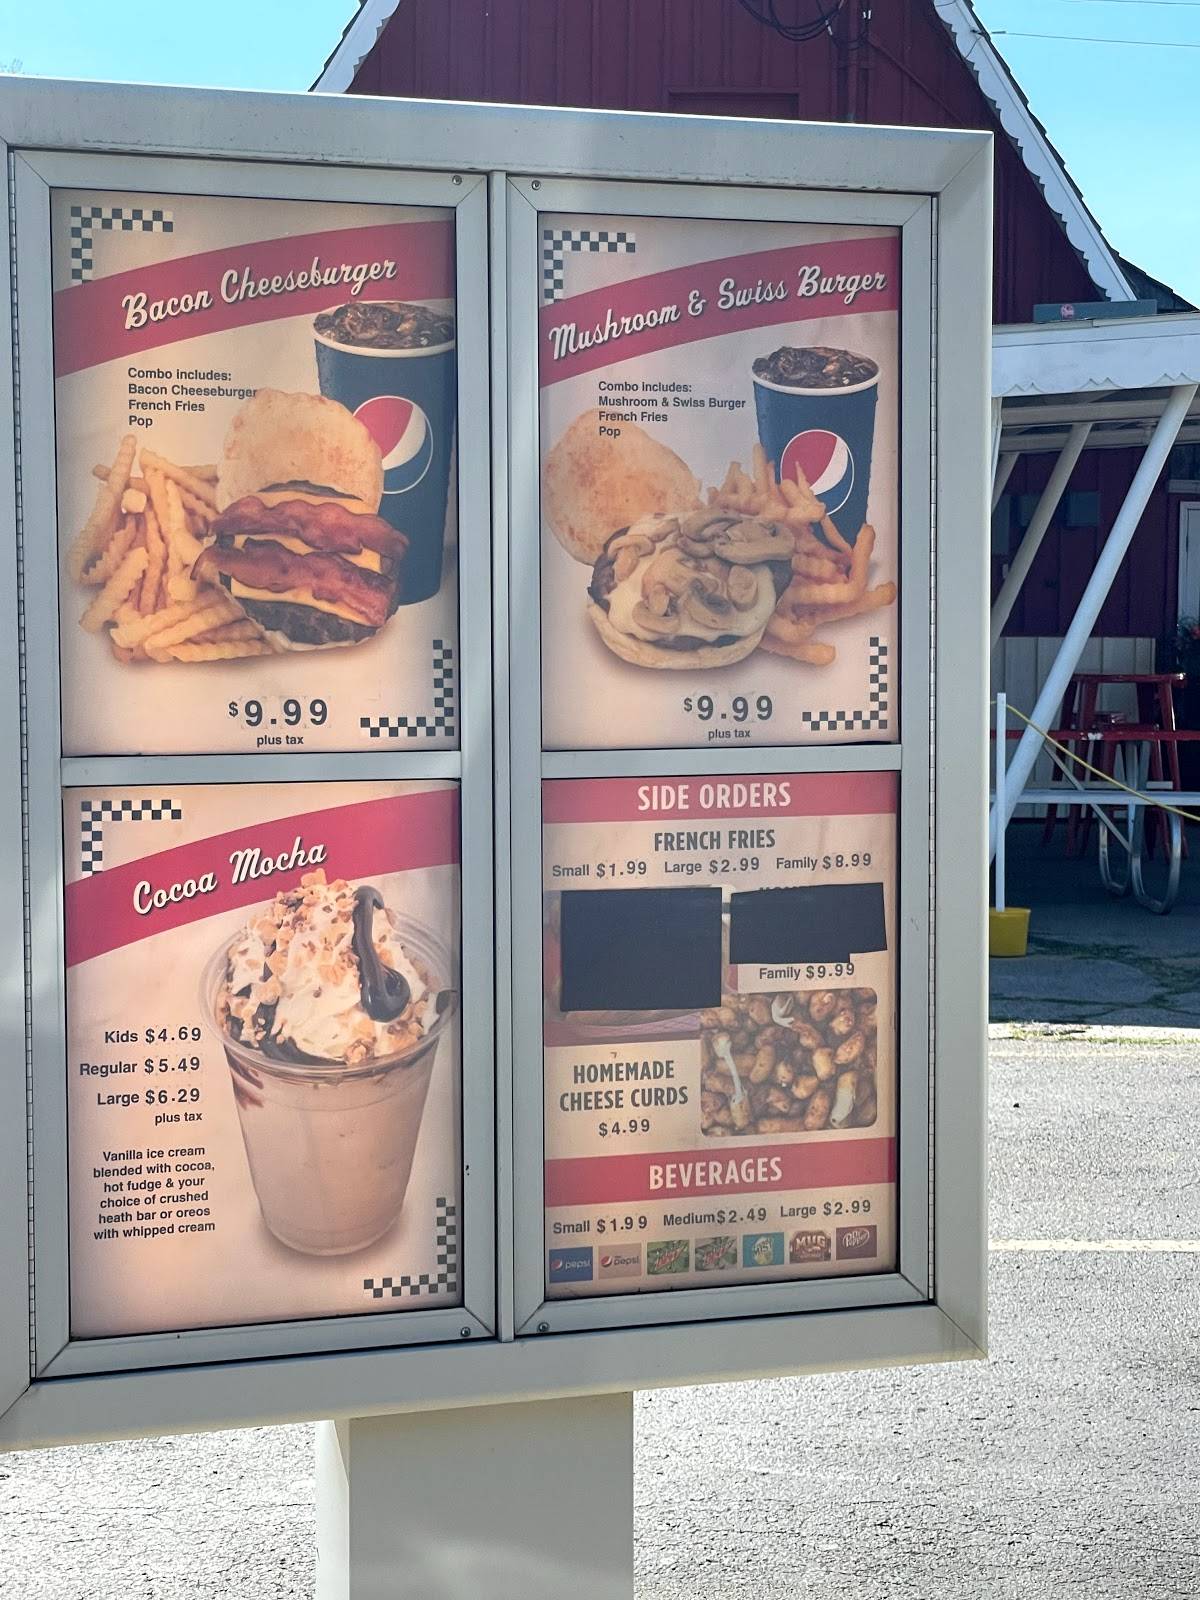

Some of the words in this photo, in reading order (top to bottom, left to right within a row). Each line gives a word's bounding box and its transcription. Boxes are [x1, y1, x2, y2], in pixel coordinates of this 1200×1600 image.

[122, 291, 212, 331] Bacon
[220, 257, 398, 303] Cheeseburger
[549, 304, 680, 360] Mushroom
[688, 290, 706, 316] &
[718, 278, 788, 310] Swiss
[798, 266, 886, 304] Burger
[128, 368, 172, 380] Combo
[176, 369, 231, 381] includes:
[128, 384, 169, 396] Bacon
[172, 385, 257, 400] Cheeseburger
[598, 381, 638, 392] Combo
[642, 382, 692, 392] includes:
[128, 400, 172, 412] French
[175, 400, 205, 412] Fries
[599, 396, 659, 408] Mushroom
[662, 398, 670, 408] &
[673, 398, 706, 408] Swiss
[708, 398, 746, 410] Burger
[128, 415, 153, 428] Pop
[599, 411, 638, 422] French
[641, 412, 668, 422] Fries
[599, 426, 621, 438] Pop
[228, 699, 328, 726] $9.99
[684, 696, 772, 722] $9.99
[257, 735, 282, 747] plus
[286, 735, 304, 744] tax
[708, 729, 730, 740] plus
[734, 729, 750, 738] tax
[638, 784, 689, 811] SIDE
[700, 782, 792, 809] ORDERS
[654, 831, 720, 852] FRENCH
[728, 829, 776, 849] FRIES
[552, 865, 590, 877] Small
[596, 862, 648, 878] $1.99
[664, 862, 702, 875] Large
[709, 857, 760, 874] $2.99
[776, 857, 818, 871] Family
[822, 854, 872, 868] $8.99
[133, 872, 218, 916] Cocoa
[229, 836, 326, 884] Mocha
[760, 968, 800, 982] Family
[806, 962, 855, 979] $9.99
[104, 1030, 138, 1044] Kids
[145, 1026, 201, 1044] $4.69
[80, 1062, 138, 1078] Regular
[144, 1056, 200, 1074] $5.49
[574, 1060, 674, 1084] HOMEMADE
[97, 1092, 139, 1106] Large
[145, 1088, 200, 1106] $6.29
[560, 1090, 624, 1112] CHEESE
[631, 1086, 688, 1108] CURDS
[155, 1112, 180, 1126] plus
[184, 1111, 202, 1122] tax
[598, 1119, 650, 1137] $4.99
[103, 1150, 142, 1162] Vanilla
[146, 1148, 164, 1159] ice
[168, 1147, 205, 1158] cream
[93, 1165, 142, 1178] blended
[146, 1164, 171, 1174] with
[175, 1162, 215, 1174] cocoa,
[650, 1156, 782, 1190] BEVERAGES
[104, 1182, 124, 1192] hot
[127, 1180, 162, 1192] fudge
[166, 1178, 174, 1188] &
[178, 1178, 205, 1190] your
[100, 1196, 140, 1208] choice
[144, 1194, 156, 1206] of
[160, 1191, 208, 1204] crushed
[98, 1212, 132, 1224] heath
[136, 1210, 156, 1220] bar
[160, 1210, 172, 1219] or
[176, 1208, 210, 1218] oreos
[553, 1221, 590, 1234] Small
[596, 1216, 648, 1234] $1.99
[780, 1204, 816, 1218] Large
[823, 1200, 872, 1216] $2.99
[94, 1228, 119, 1240] with
[122, 1224, 174, 1240] whipped
[178, 1222, 216, 1234] cream
[796, 1236, 826, 1248] MUG
[565, 1260, 591, 1269] pepsi
